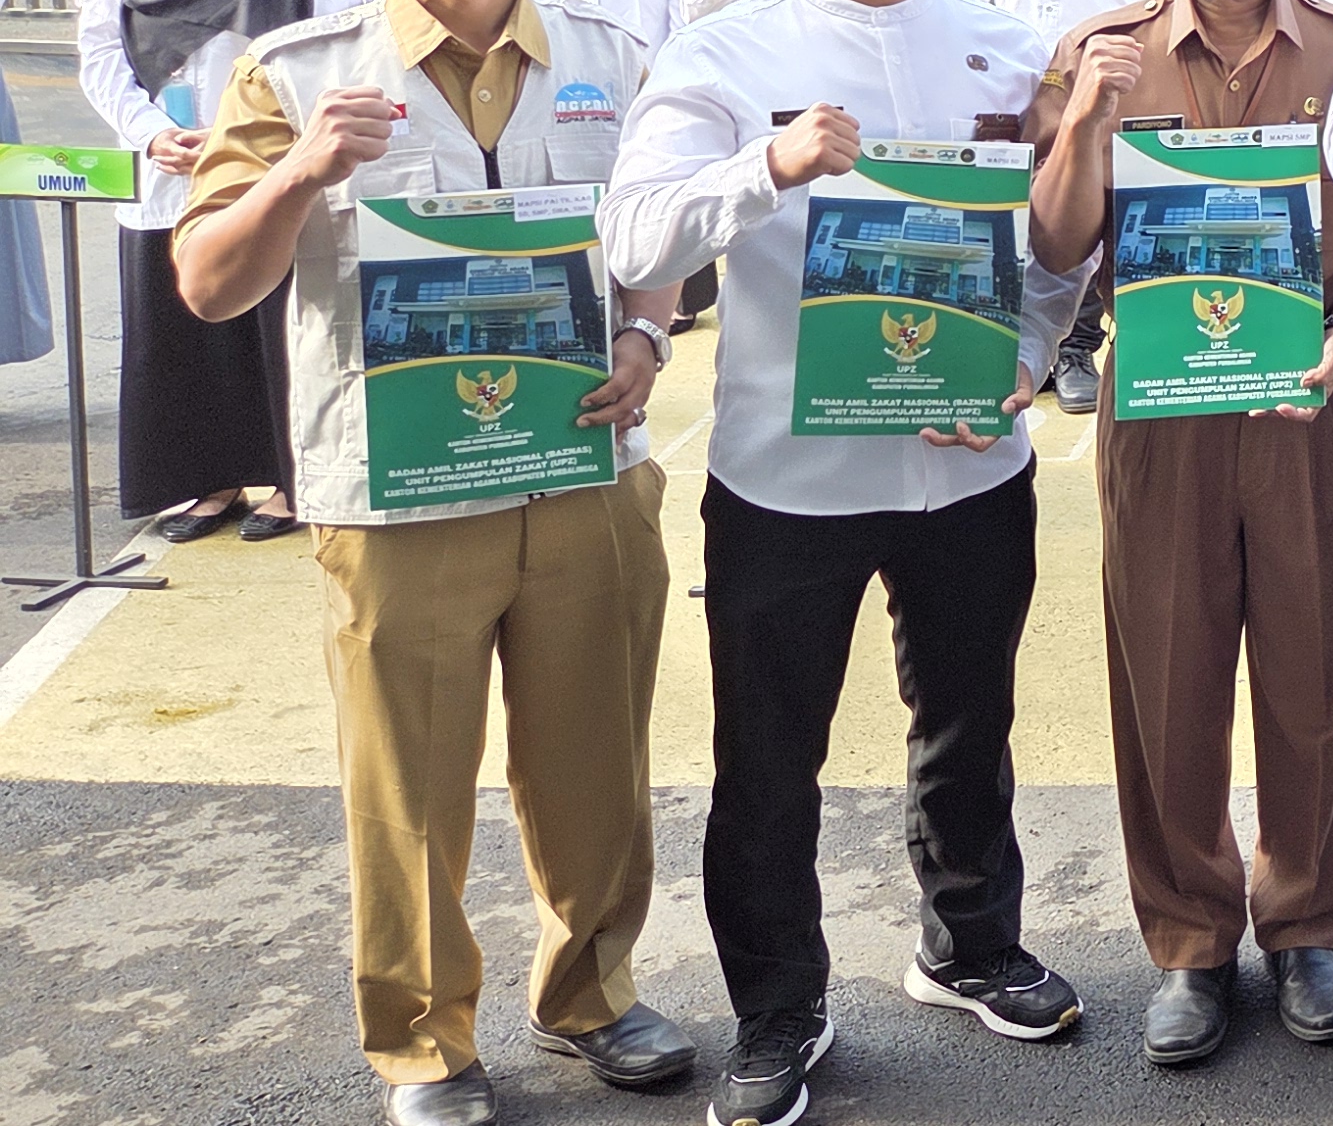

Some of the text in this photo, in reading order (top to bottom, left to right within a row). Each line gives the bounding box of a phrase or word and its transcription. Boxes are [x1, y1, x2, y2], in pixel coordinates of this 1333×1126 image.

[38, 174, 86, 192] UMUM
[896, 365, 917, 373] UPZ
[479, 422, 501, 433] UPZ
